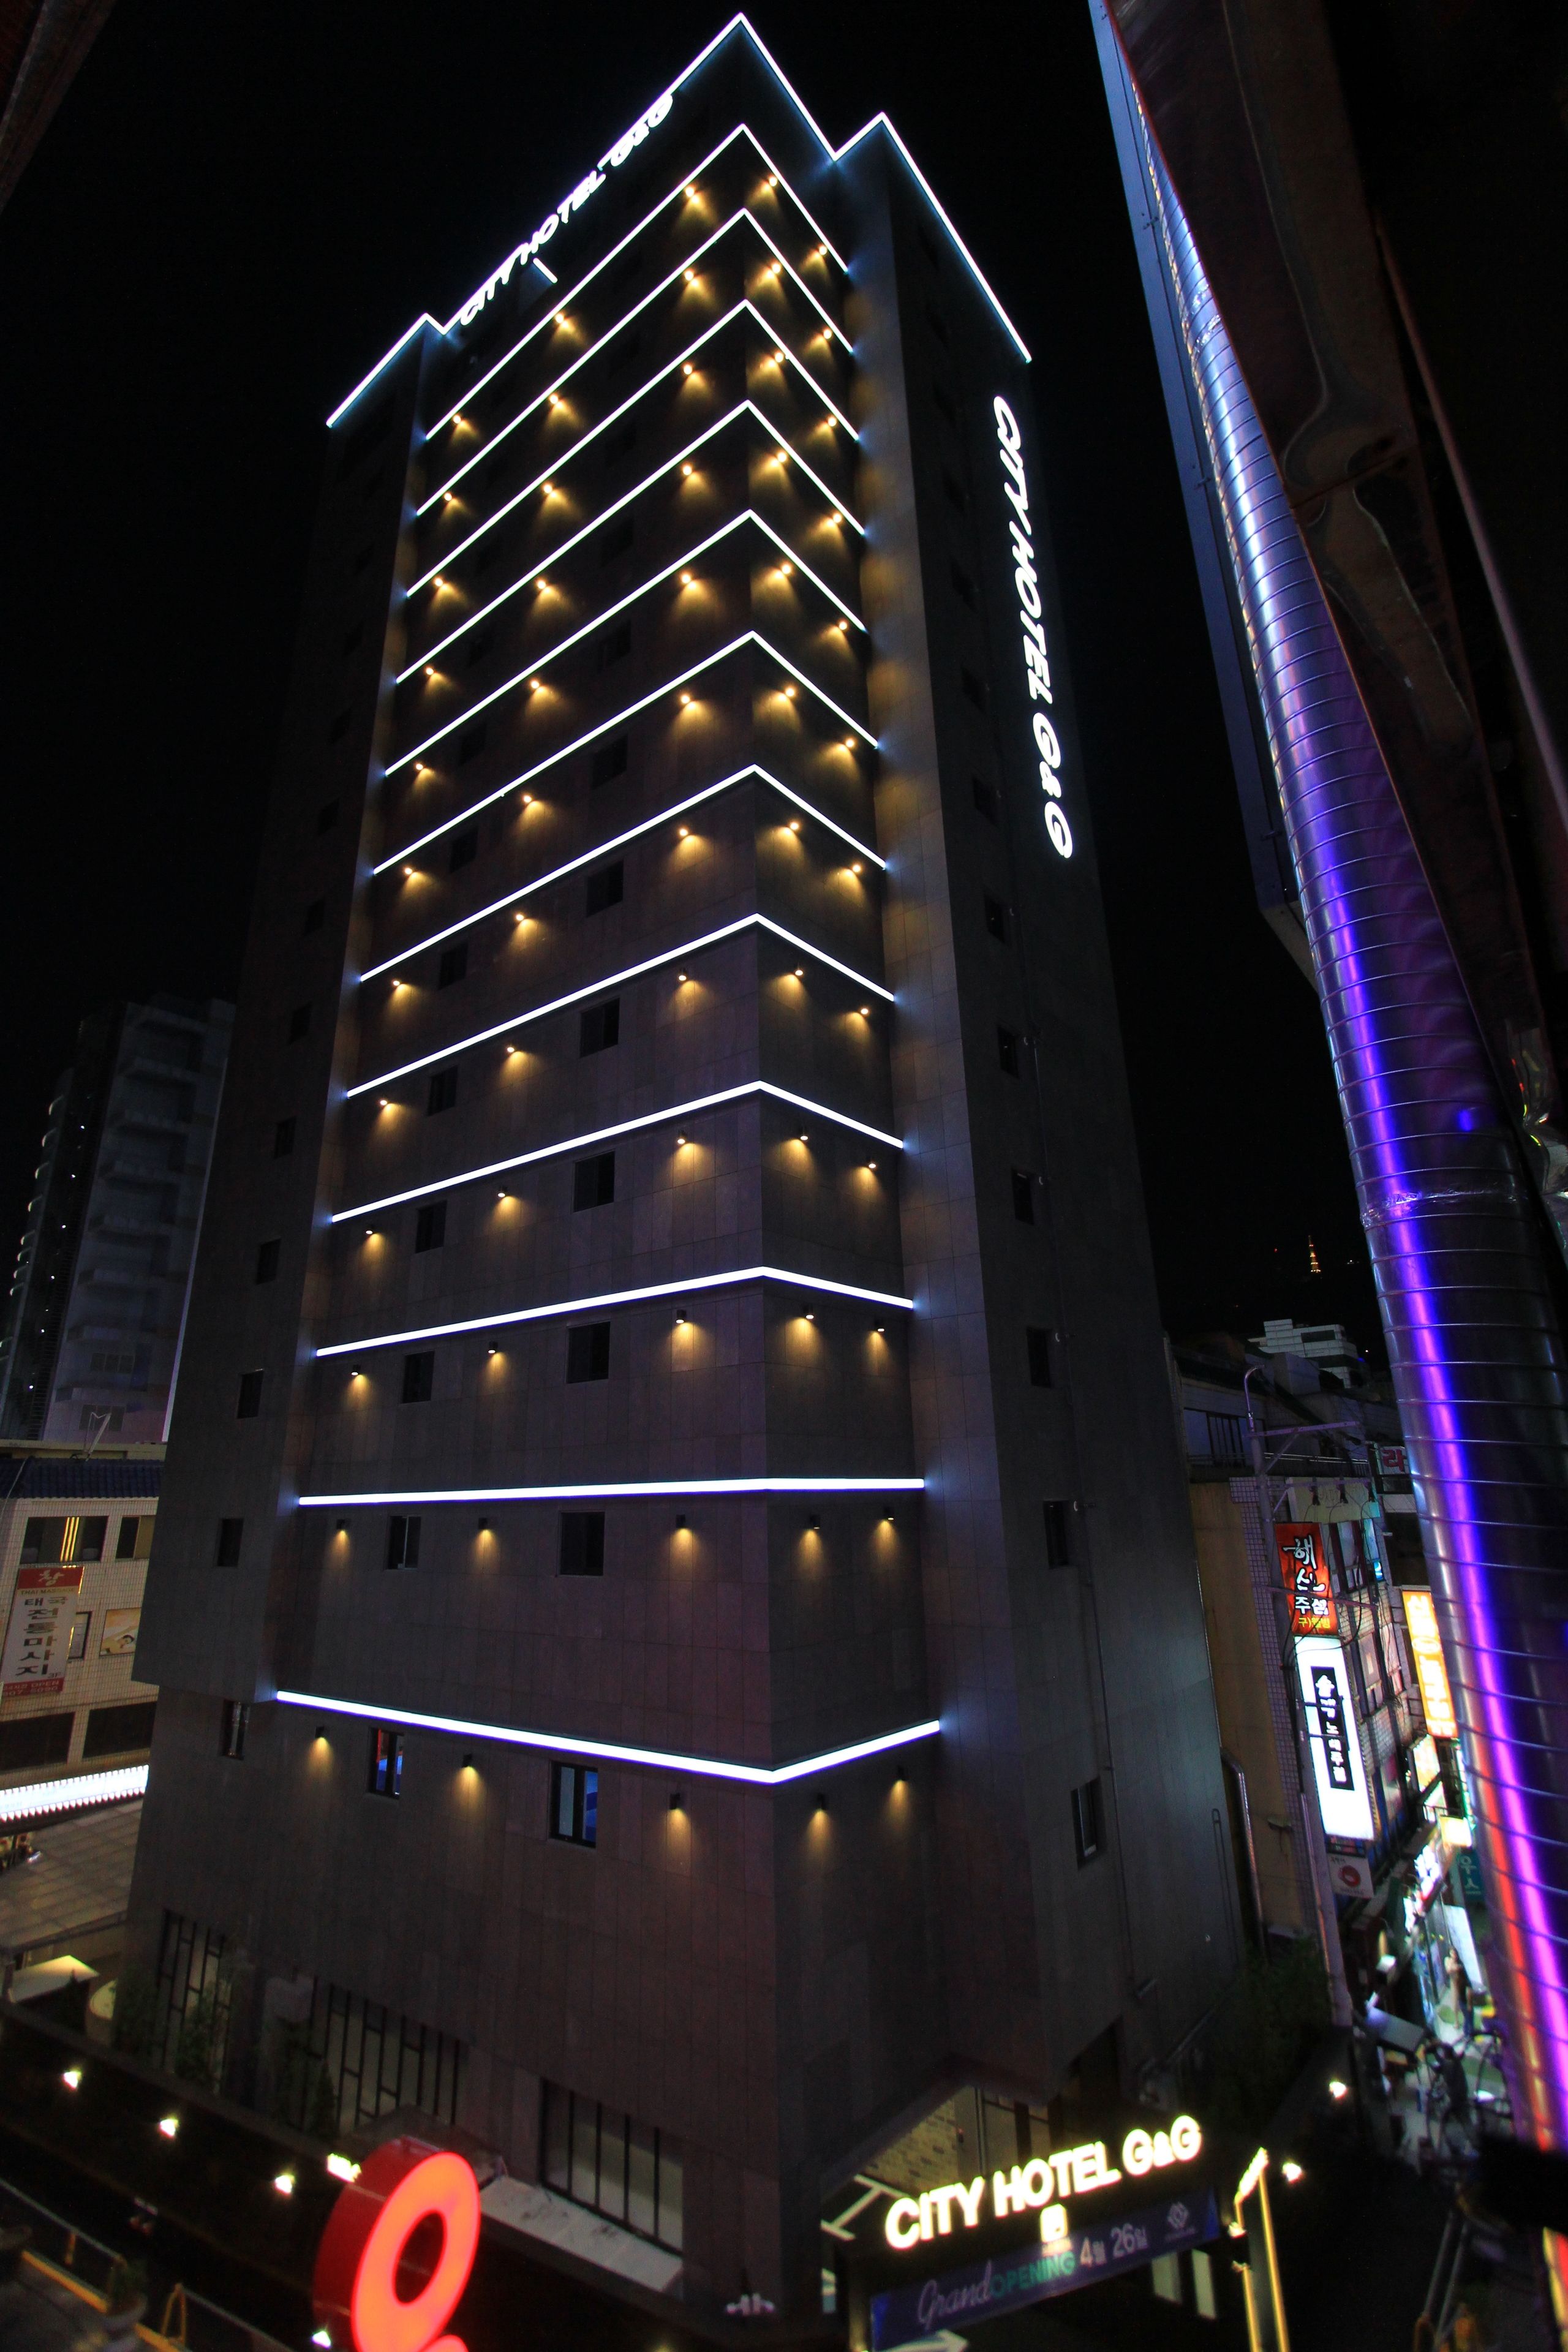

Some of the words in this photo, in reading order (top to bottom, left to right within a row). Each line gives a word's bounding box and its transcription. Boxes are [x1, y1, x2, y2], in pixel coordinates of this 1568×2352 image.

[460, 248, 519, 326] CITY
[520, 170, 606, 265] HOTEL
[993, 396, 1031, 535] CITY
[1009, 521, 1053, 704] HOTEL
[1033, 712, 1073, 859] G&G
[24, 1596, 69, 1606] 태국
[884, 2176, 985, 2250] CITY
[992, 2141, 1122, 2218] HOTEL
[1122, 2114, 1202, 2176] G&G
[918, 2260, 992, 2329] Grand
[989, 2252, 1076, 2299] OPENING
